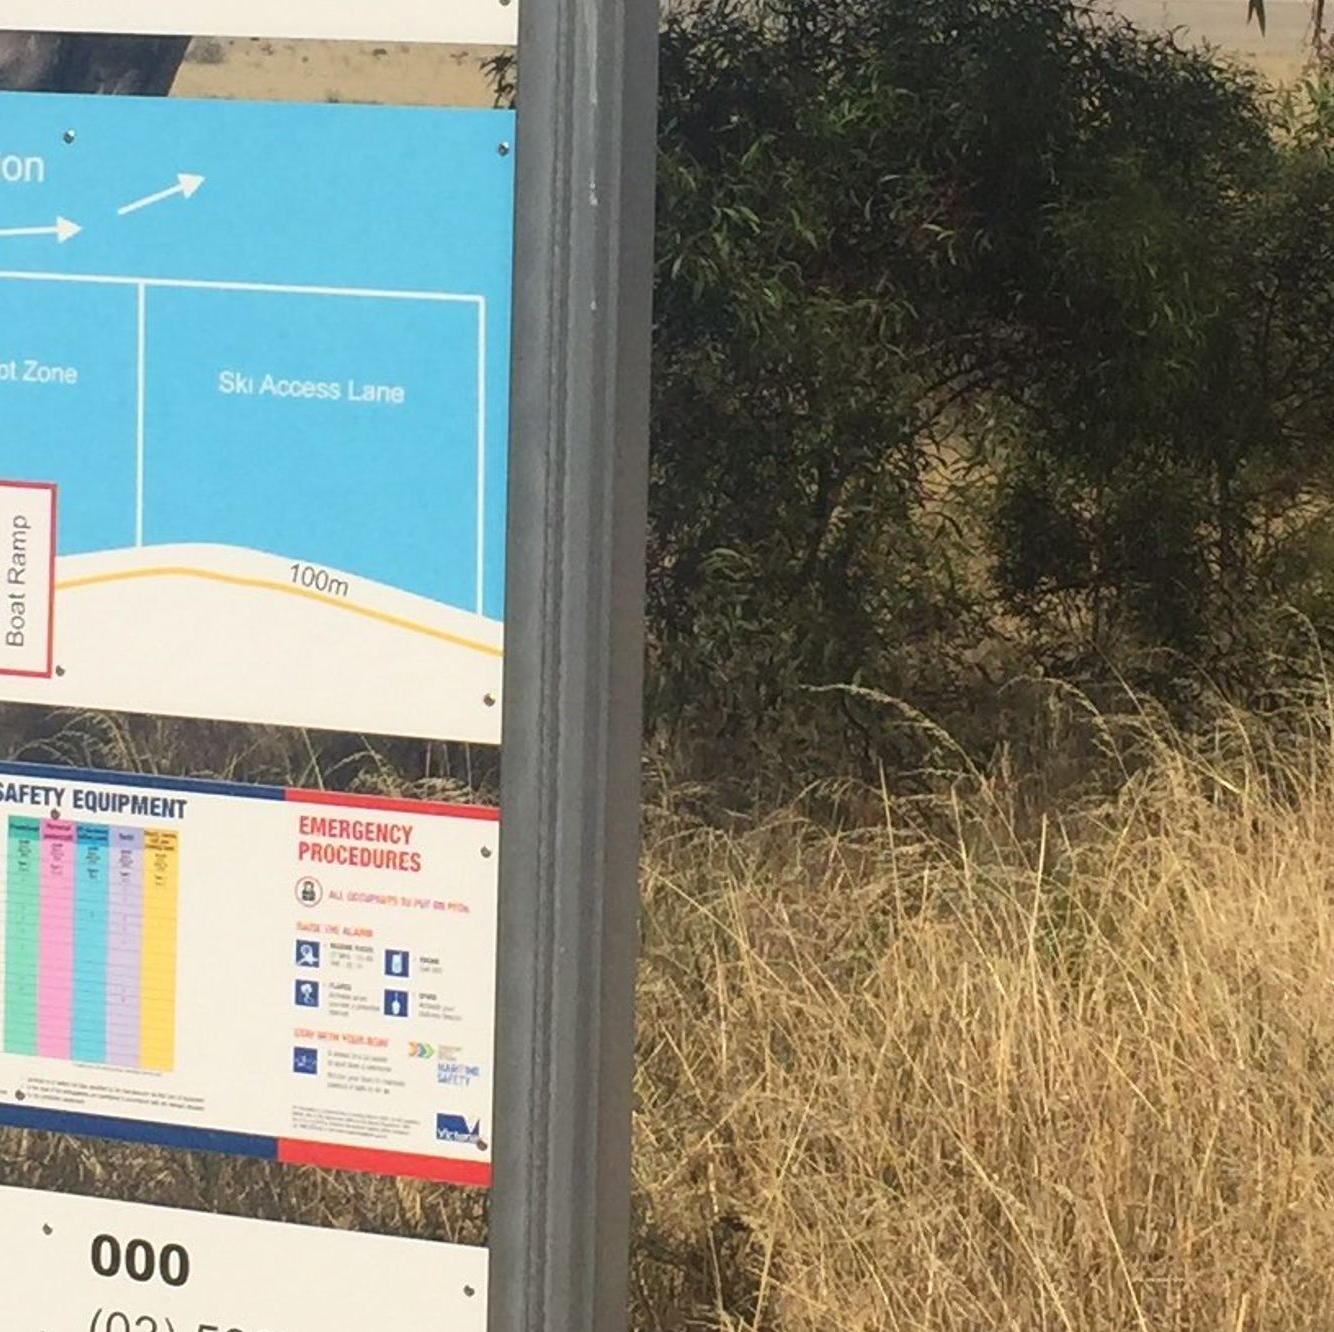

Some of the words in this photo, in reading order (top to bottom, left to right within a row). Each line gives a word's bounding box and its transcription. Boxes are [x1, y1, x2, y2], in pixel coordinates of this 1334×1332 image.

[23, 360, 78, 384] Zone
[218, 371, 253, 395] Ski
[259, 374, 341, 400] Access
[348, 380, 405, 404] Lane
[7, 514, 31, 585] Ramp
[290, 563, 349, 597] 100m
[5, 594, 25, 647] Boat
[73, 789, 188, 819] EQUIPMENT
[299, 815, 413, 845] EMERGENCY
[298, 841, 422, 873] PROCEDURES
[91, 1234, 190, 1287] 000
